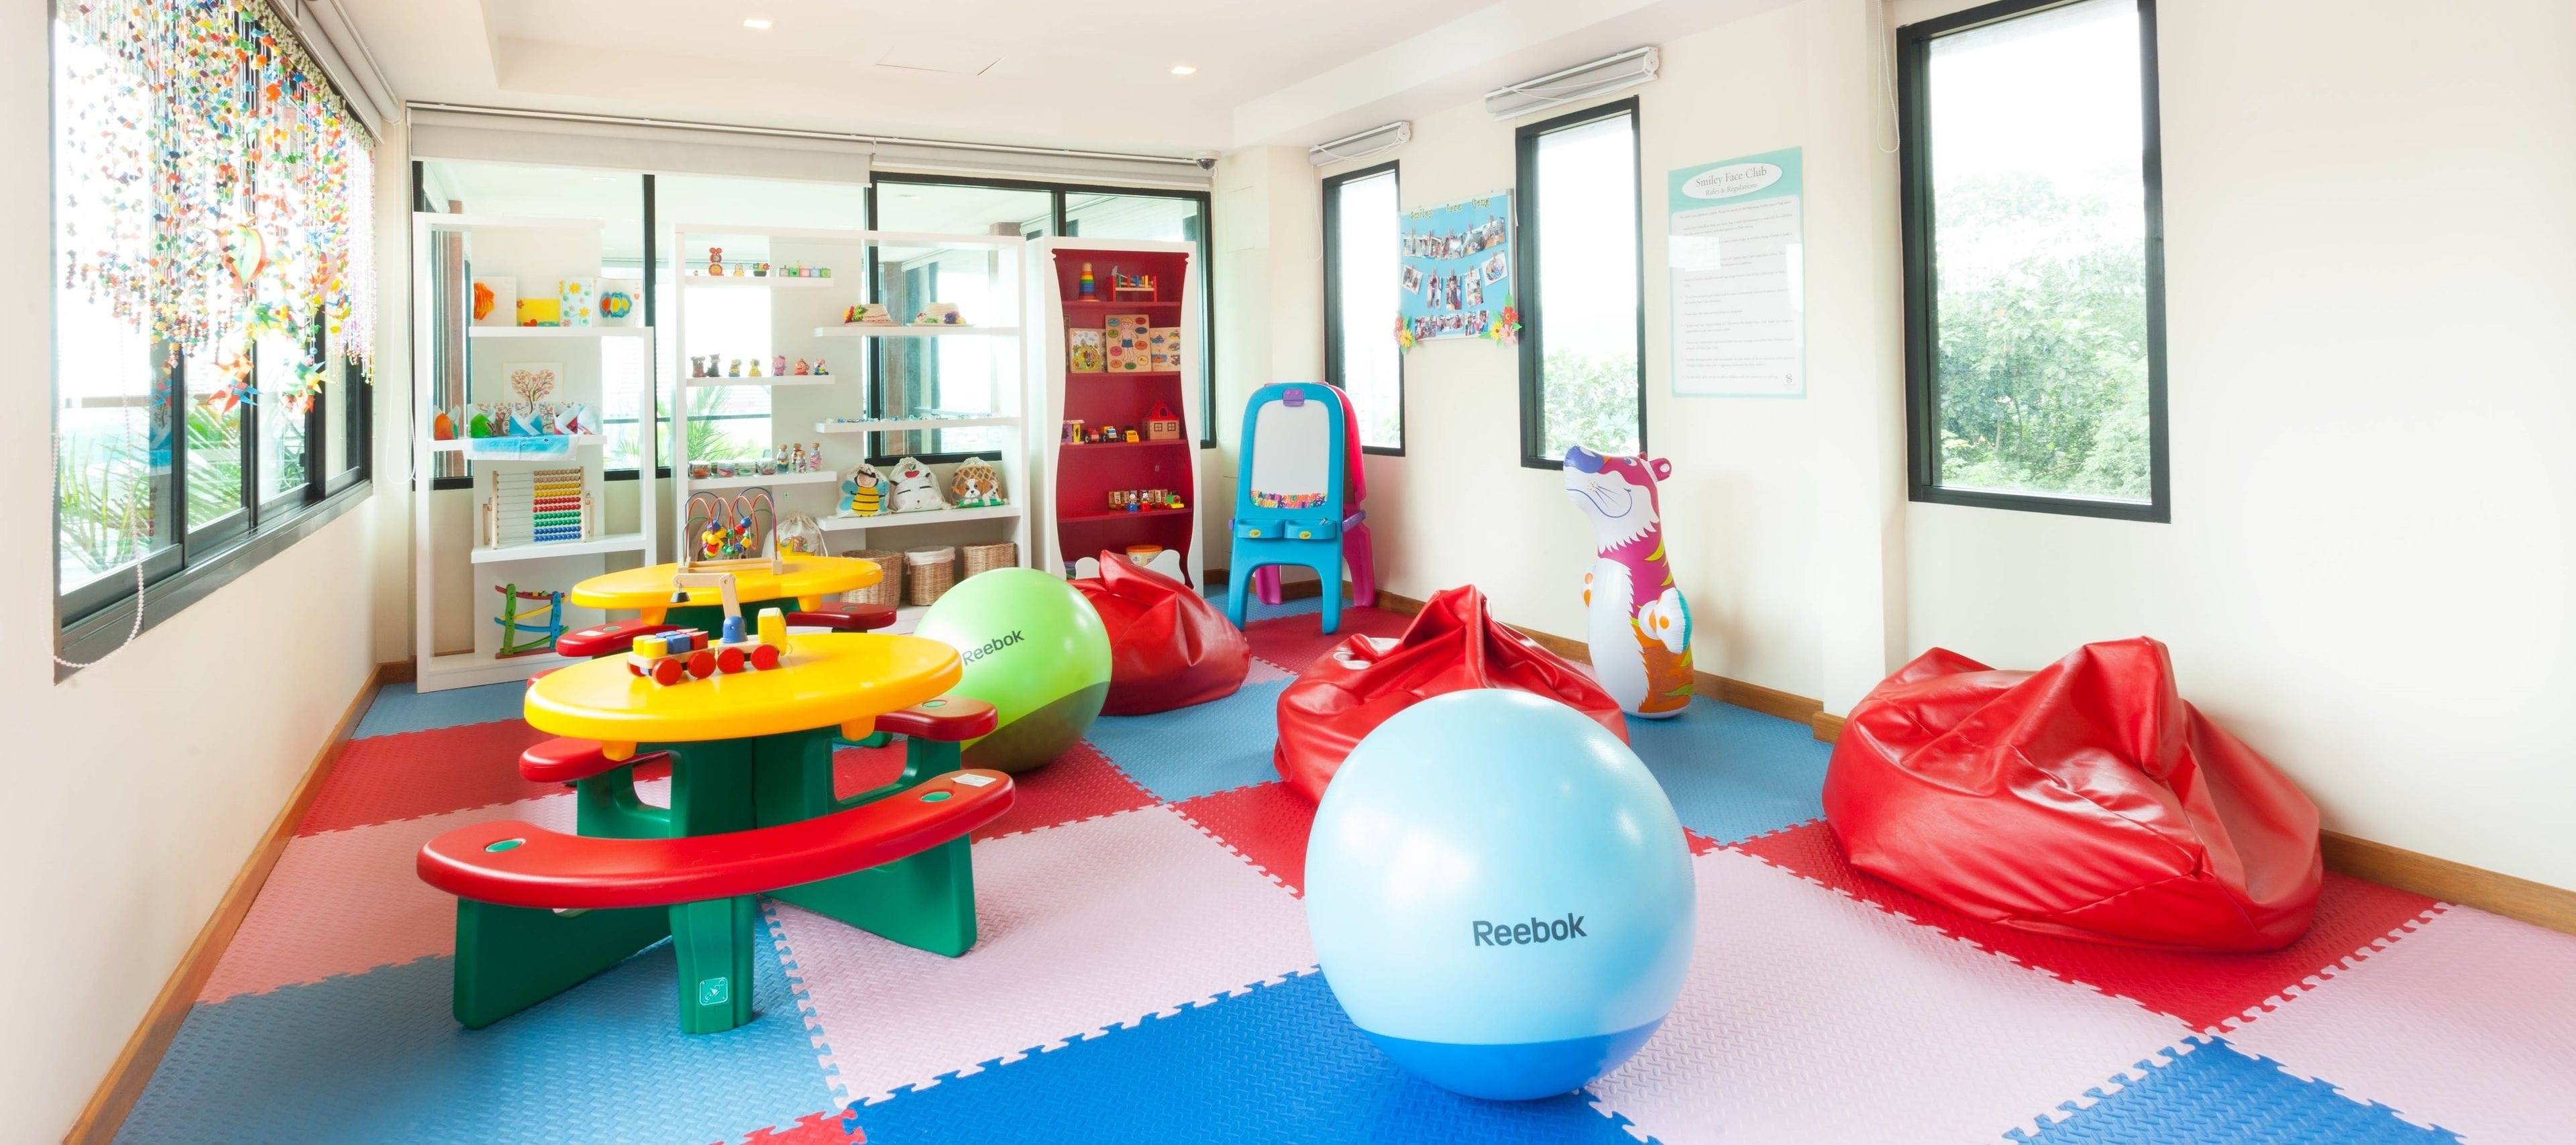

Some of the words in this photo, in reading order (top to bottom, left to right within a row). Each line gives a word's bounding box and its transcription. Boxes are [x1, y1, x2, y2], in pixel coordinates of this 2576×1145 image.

[1696, 175, 1722, 186] Smiley
[1725, 172, 1743, 182] Face
[1746, 166, 1767, 178] Club
[1705, 188, 1720, 197] Rules
[1726, 182, 1758, 193] Regulations
[962, 630, 1025, 665] Reebok
[1472, 912, 1587, 946] Reebok
